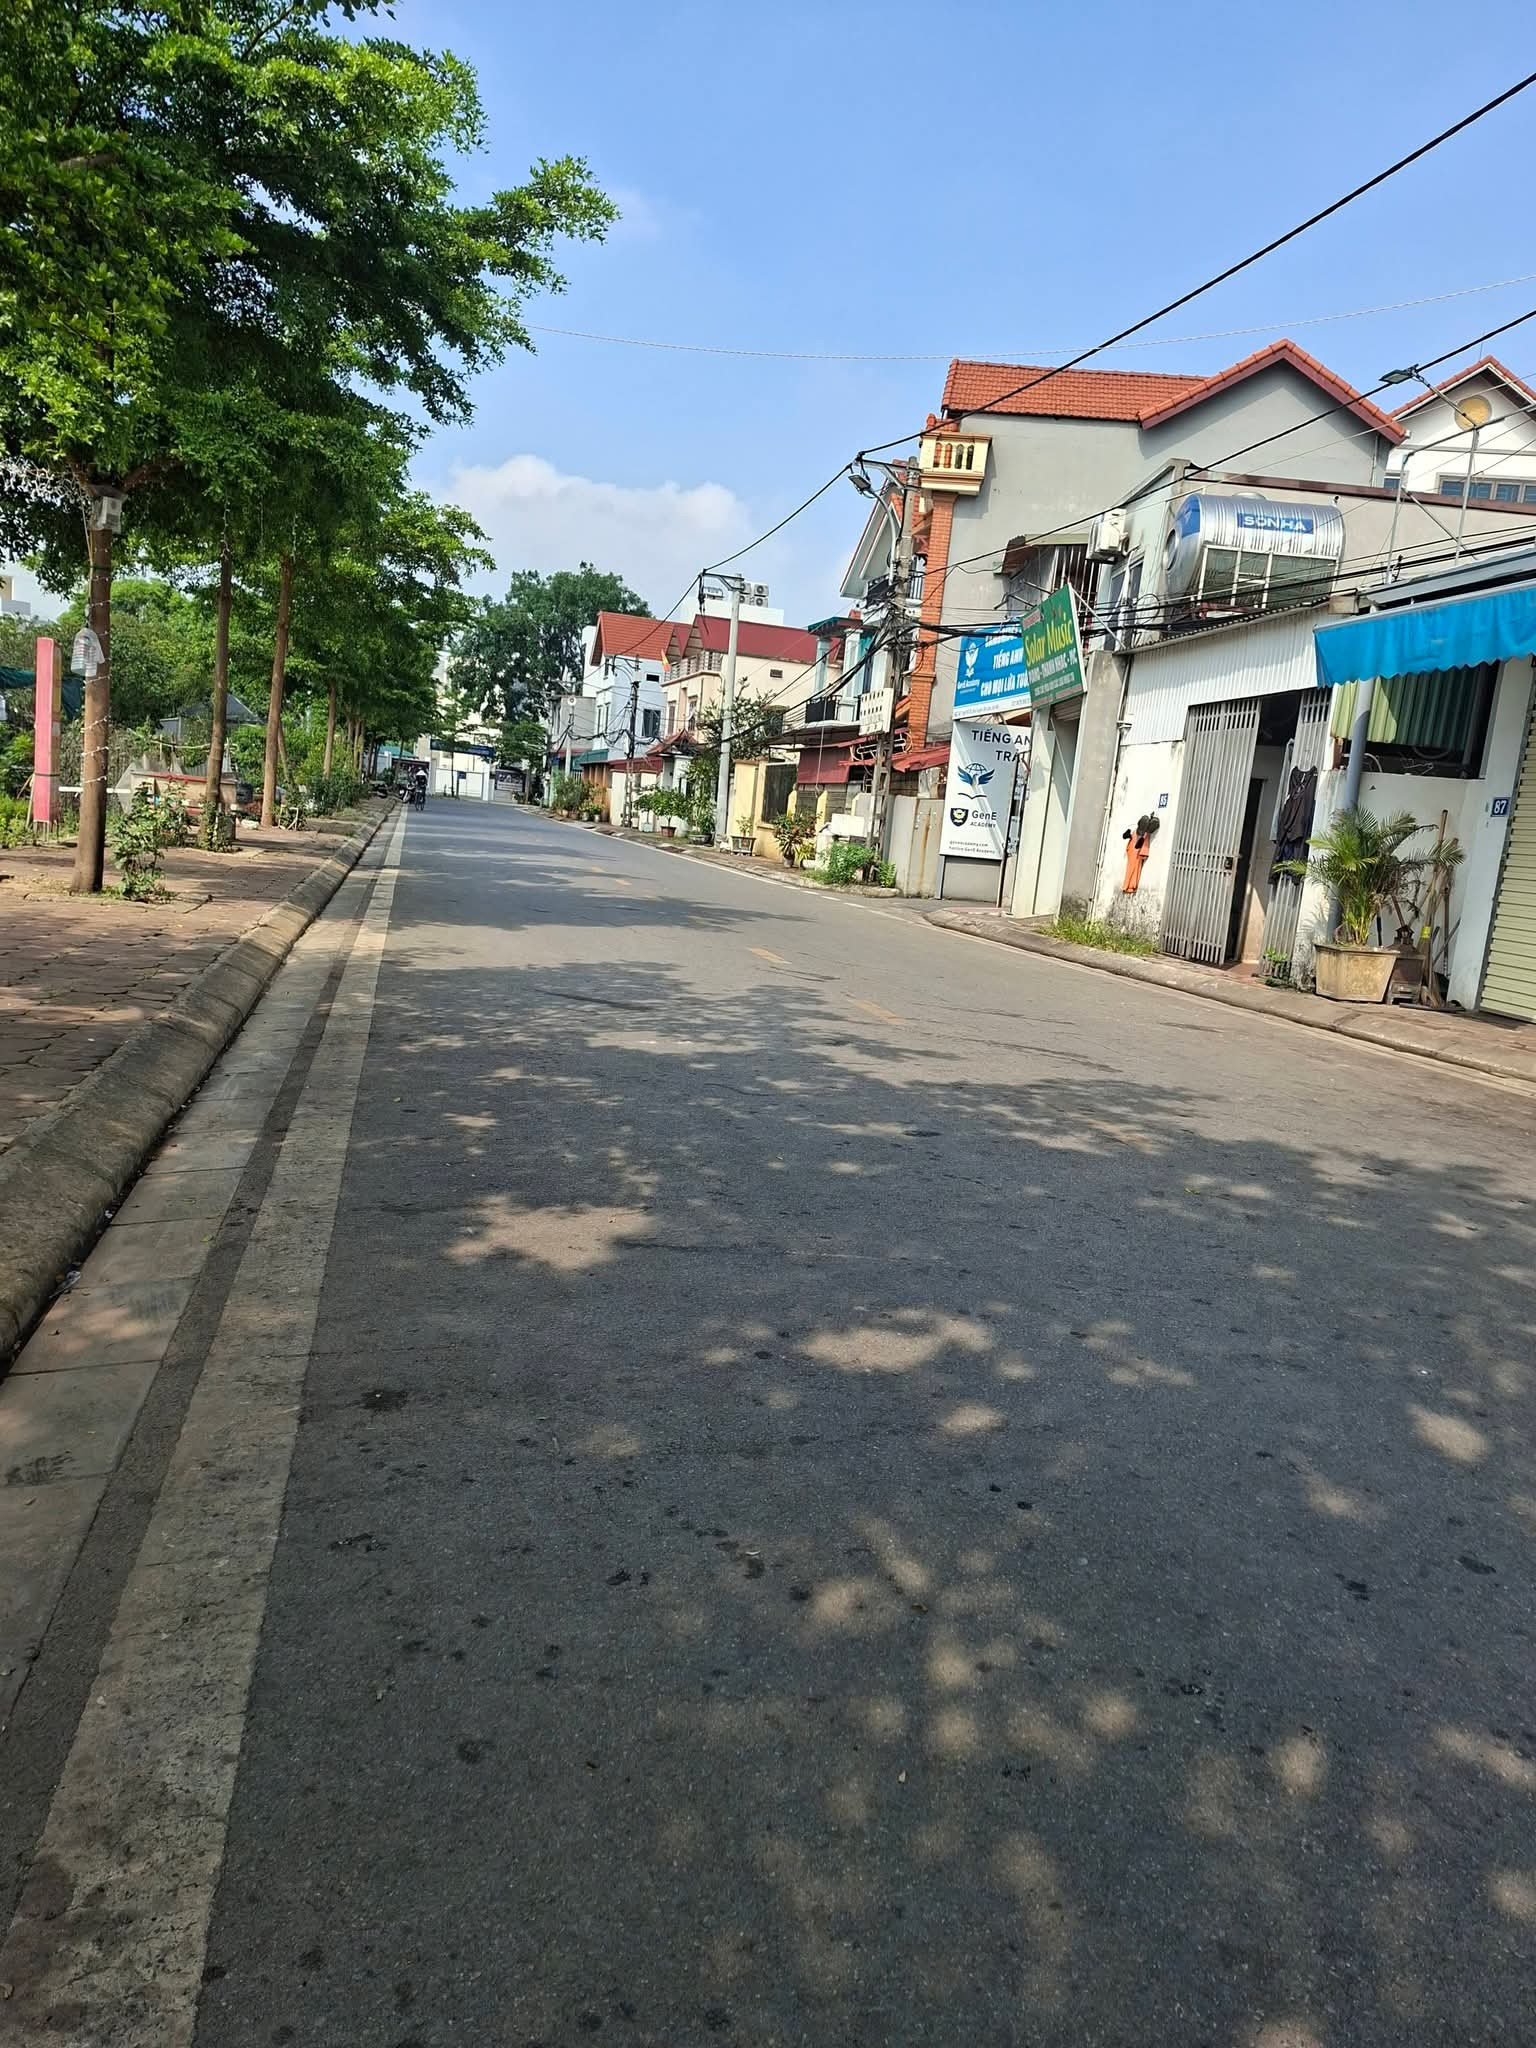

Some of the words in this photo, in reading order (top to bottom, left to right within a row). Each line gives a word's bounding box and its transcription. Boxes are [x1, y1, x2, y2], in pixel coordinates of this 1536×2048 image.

[1244, 516, 1307, 531] SONHA
[1025, 632, 1046, 667] Solar
[1047, 612, 1074, 655] Music
[972, 728, 1011, 744] TIẾNG
[1494, 800, 1507, 814] 87
[971, 810, 997, 821] GenE
